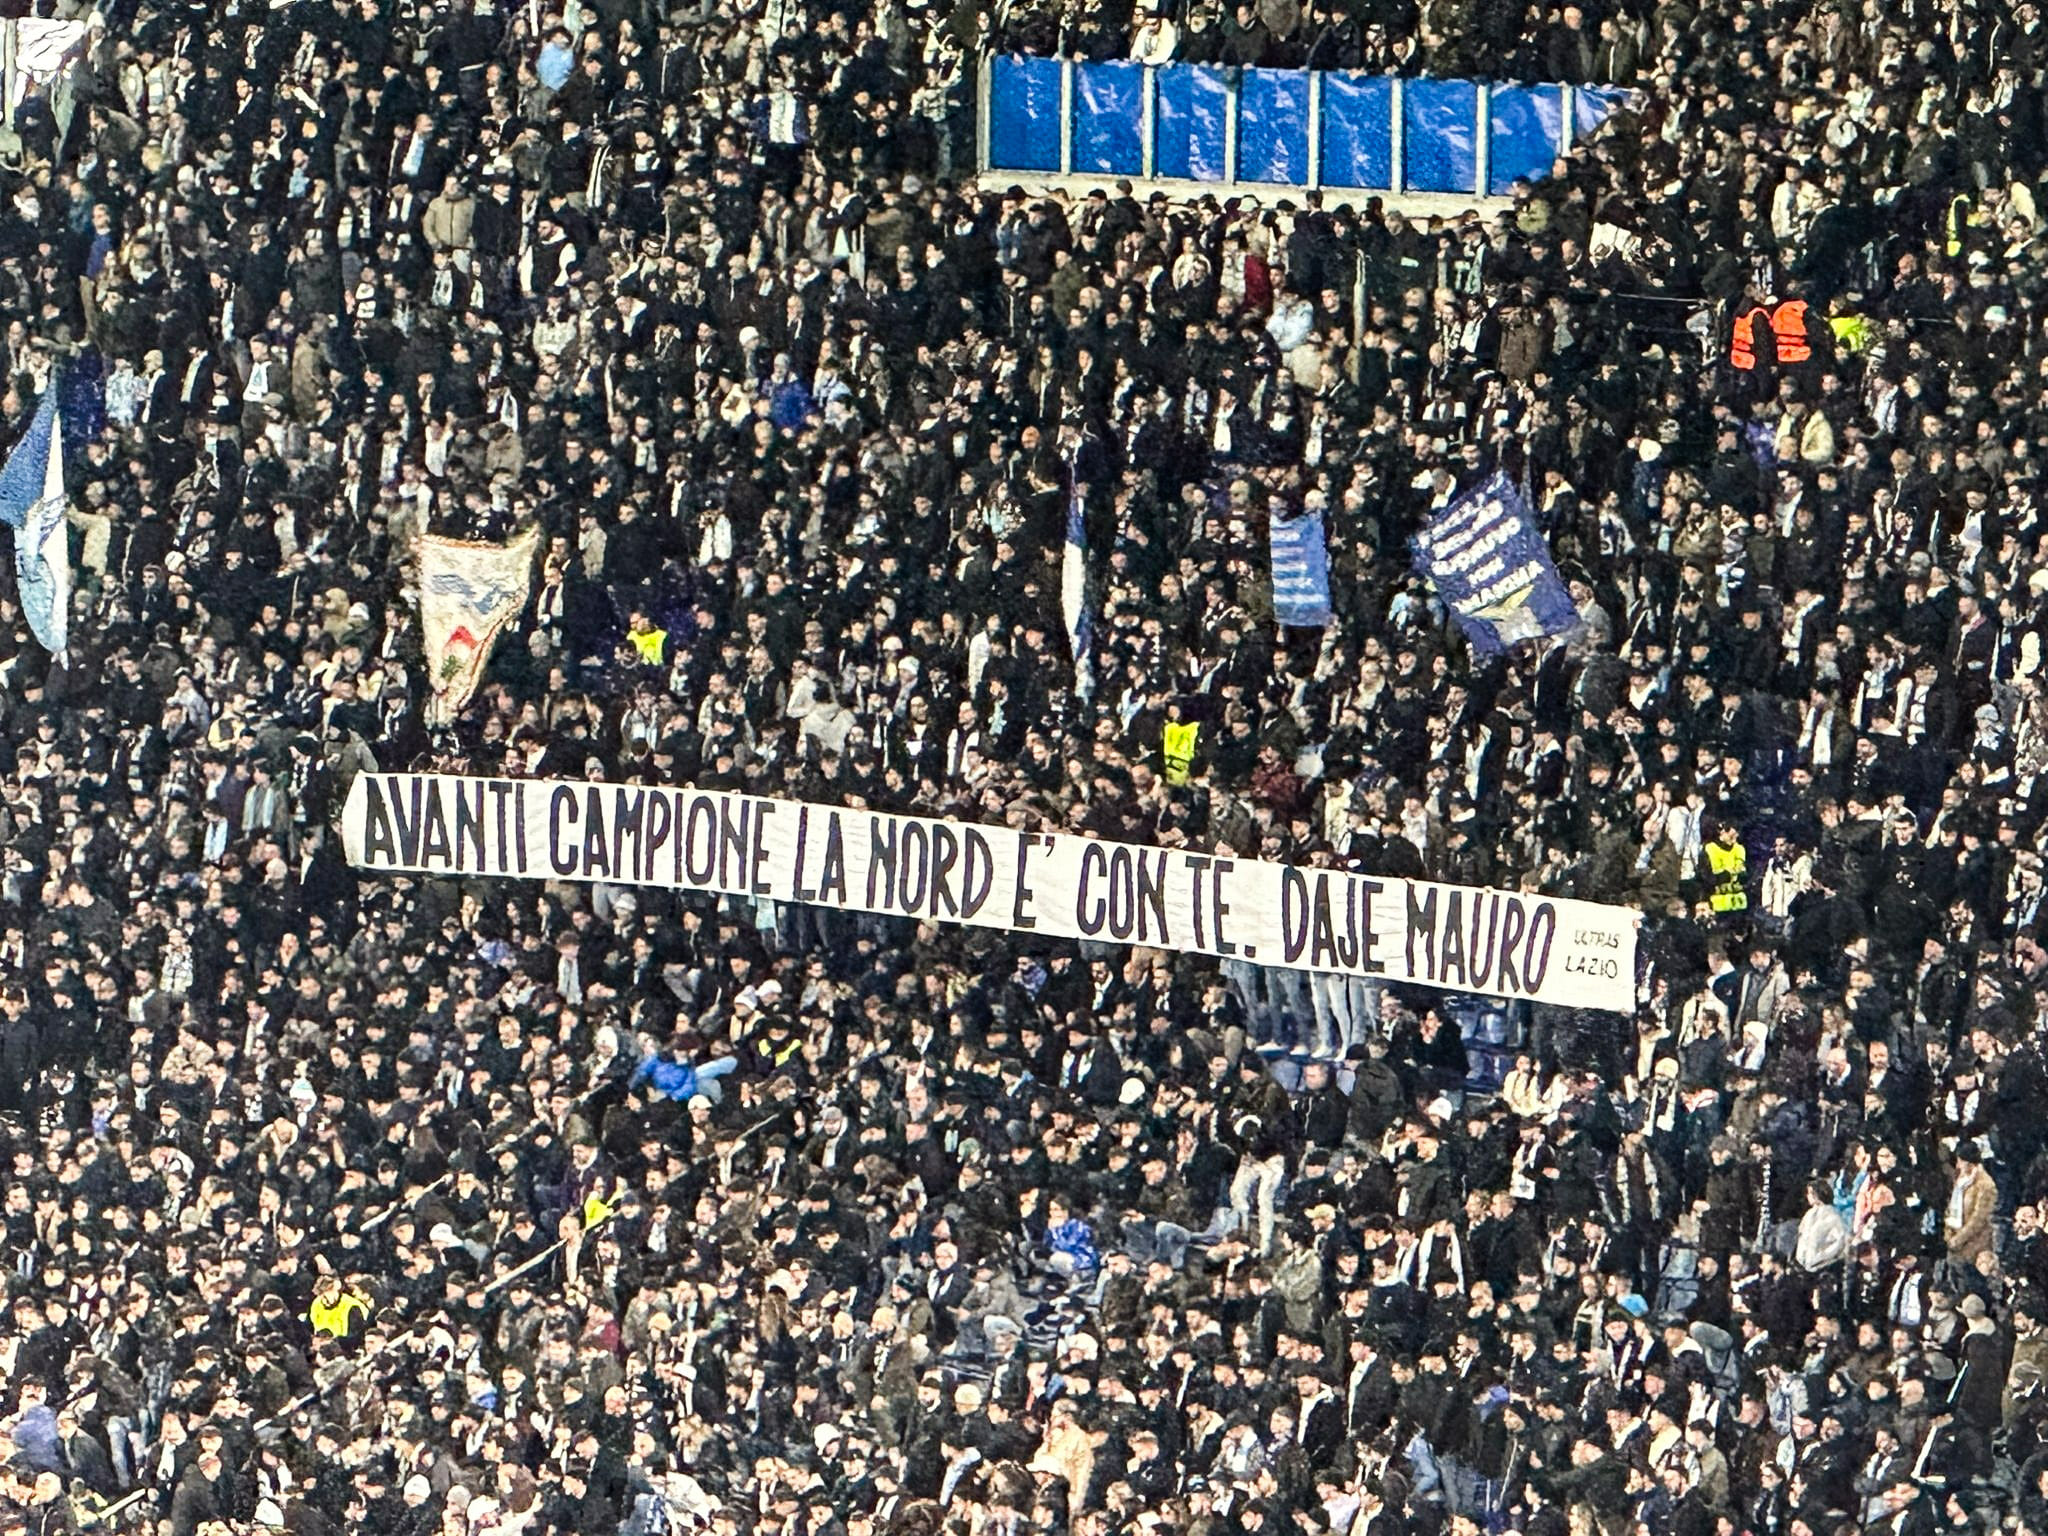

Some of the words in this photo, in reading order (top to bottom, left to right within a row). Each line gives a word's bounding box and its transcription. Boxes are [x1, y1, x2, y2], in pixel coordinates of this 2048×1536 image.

[364, 776, 527, 874] AVANTI
[550, 784, 776, 895] CAMPIONE
[793, 805, 847, 903] LA
[866, 815, 994, 919] NORD
[1076, 842, 1170, 944] CON
[1184, 855, 1258, 959] TE.
[1281, 865, 1386, 974] DAJE
[1405, 882, 1557, 996] MAURO
[1565, 955, 1618, 979] LAZIO
